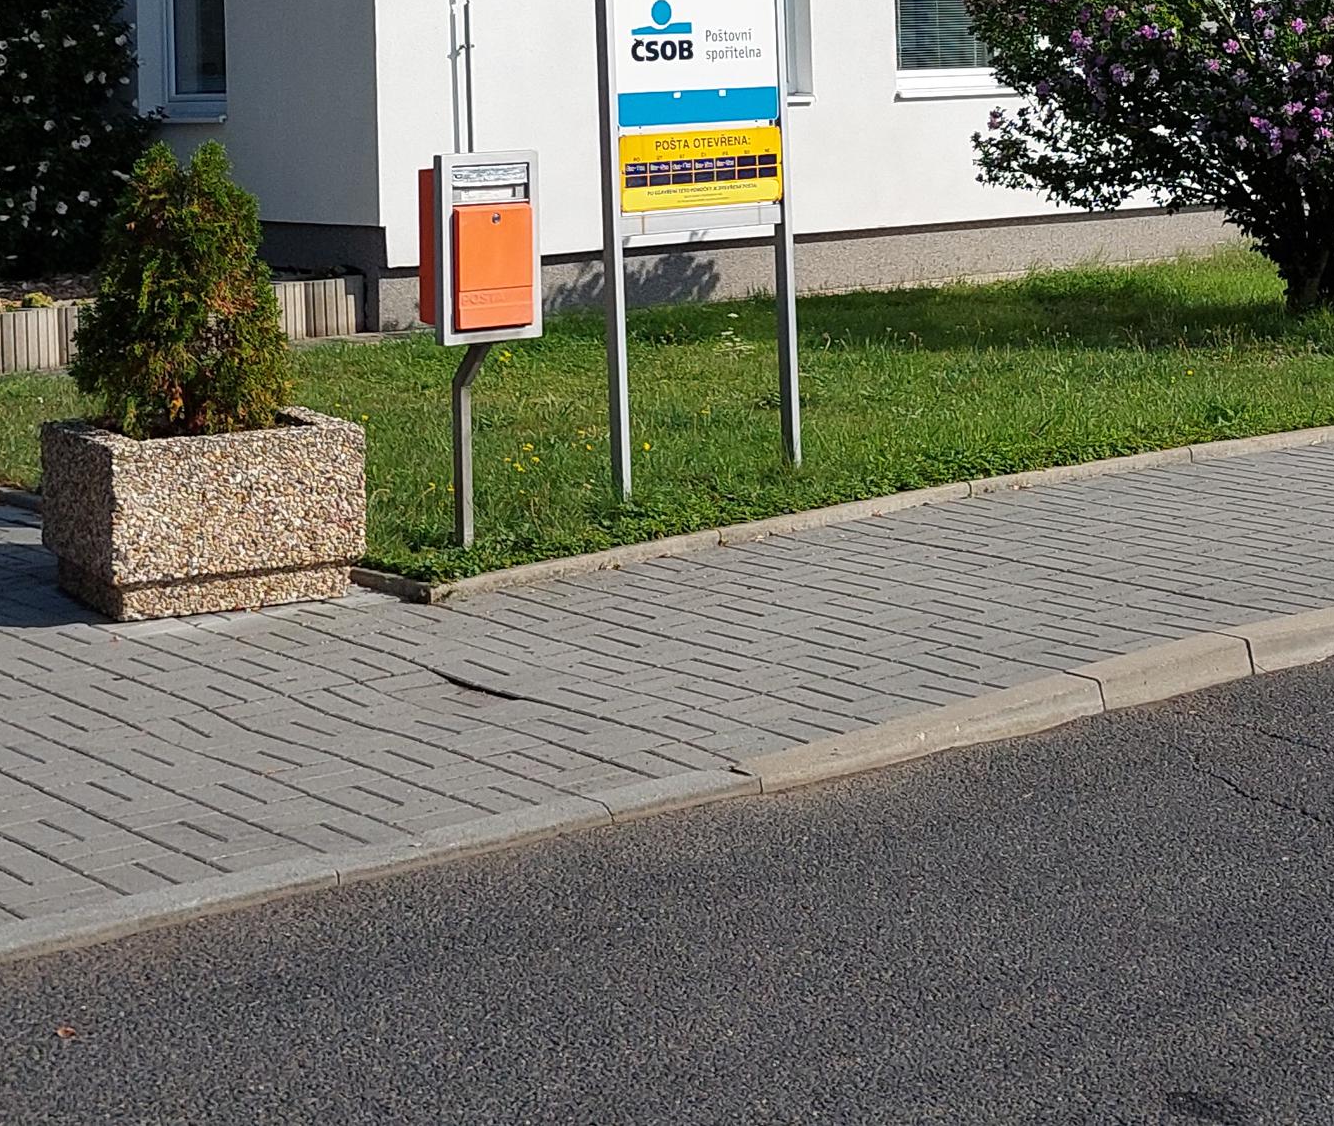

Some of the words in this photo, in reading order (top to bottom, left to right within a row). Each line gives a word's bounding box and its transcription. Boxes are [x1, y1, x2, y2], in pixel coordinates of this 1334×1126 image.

[705, 28, 752, 42] Poštovní
[631, 38, 694, 62] ČSOB
[705, 46, 762, 62] spořitelna
[655, 137, 690, 151] POŠTA
[693, 134, 751, 149] OTEVŘENA:
